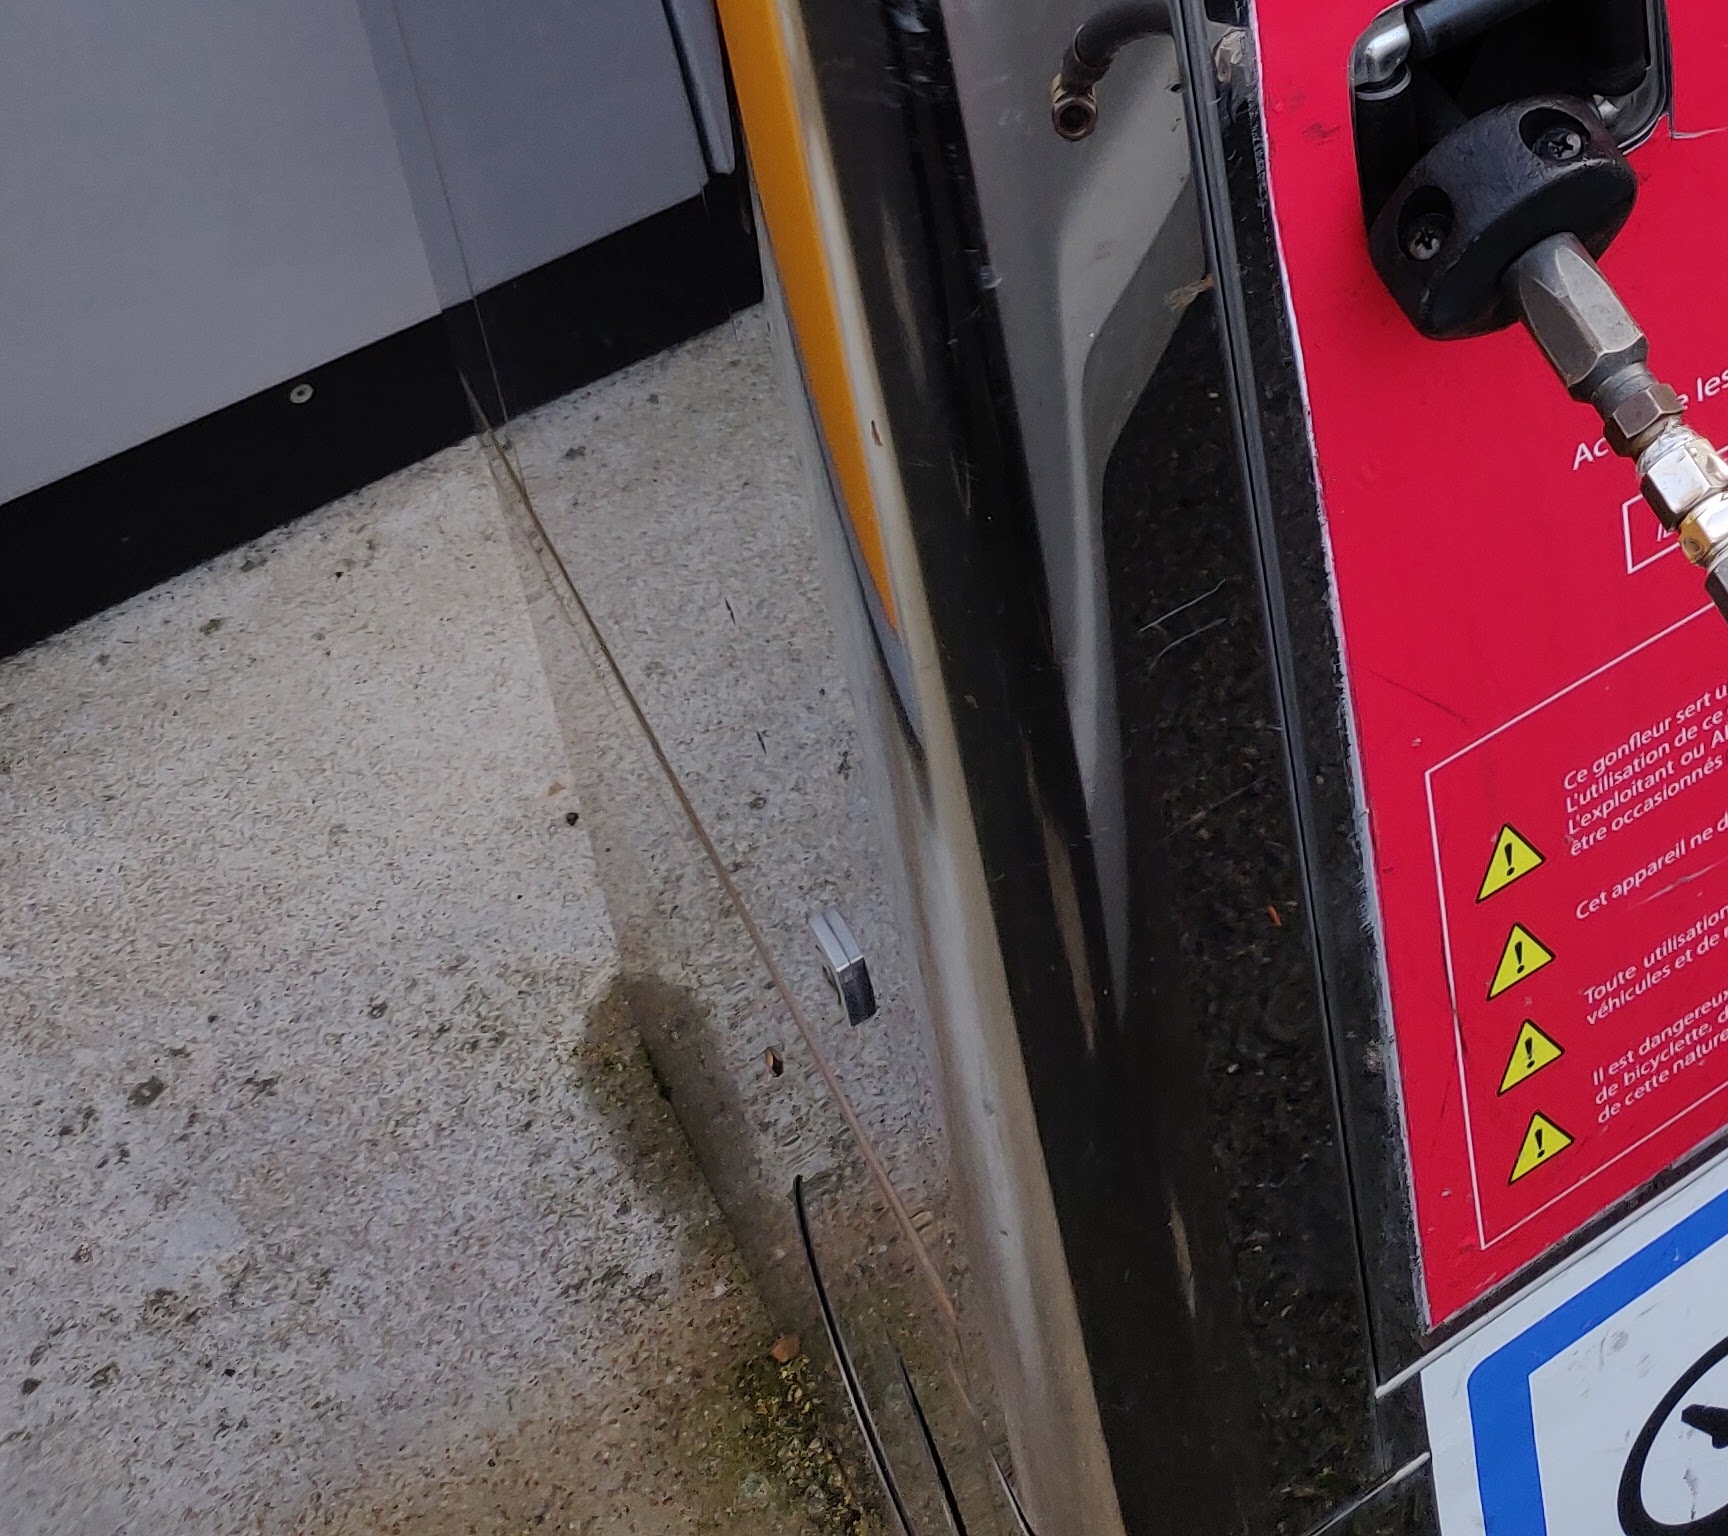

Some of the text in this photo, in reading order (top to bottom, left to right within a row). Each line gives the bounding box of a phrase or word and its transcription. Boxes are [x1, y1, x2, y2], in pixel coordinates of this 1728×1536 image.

[1575, 890, 1607, 919] Cet
[1611, 838, 1686, 898] appareil
[1689, 826, 1713, 849] ne
